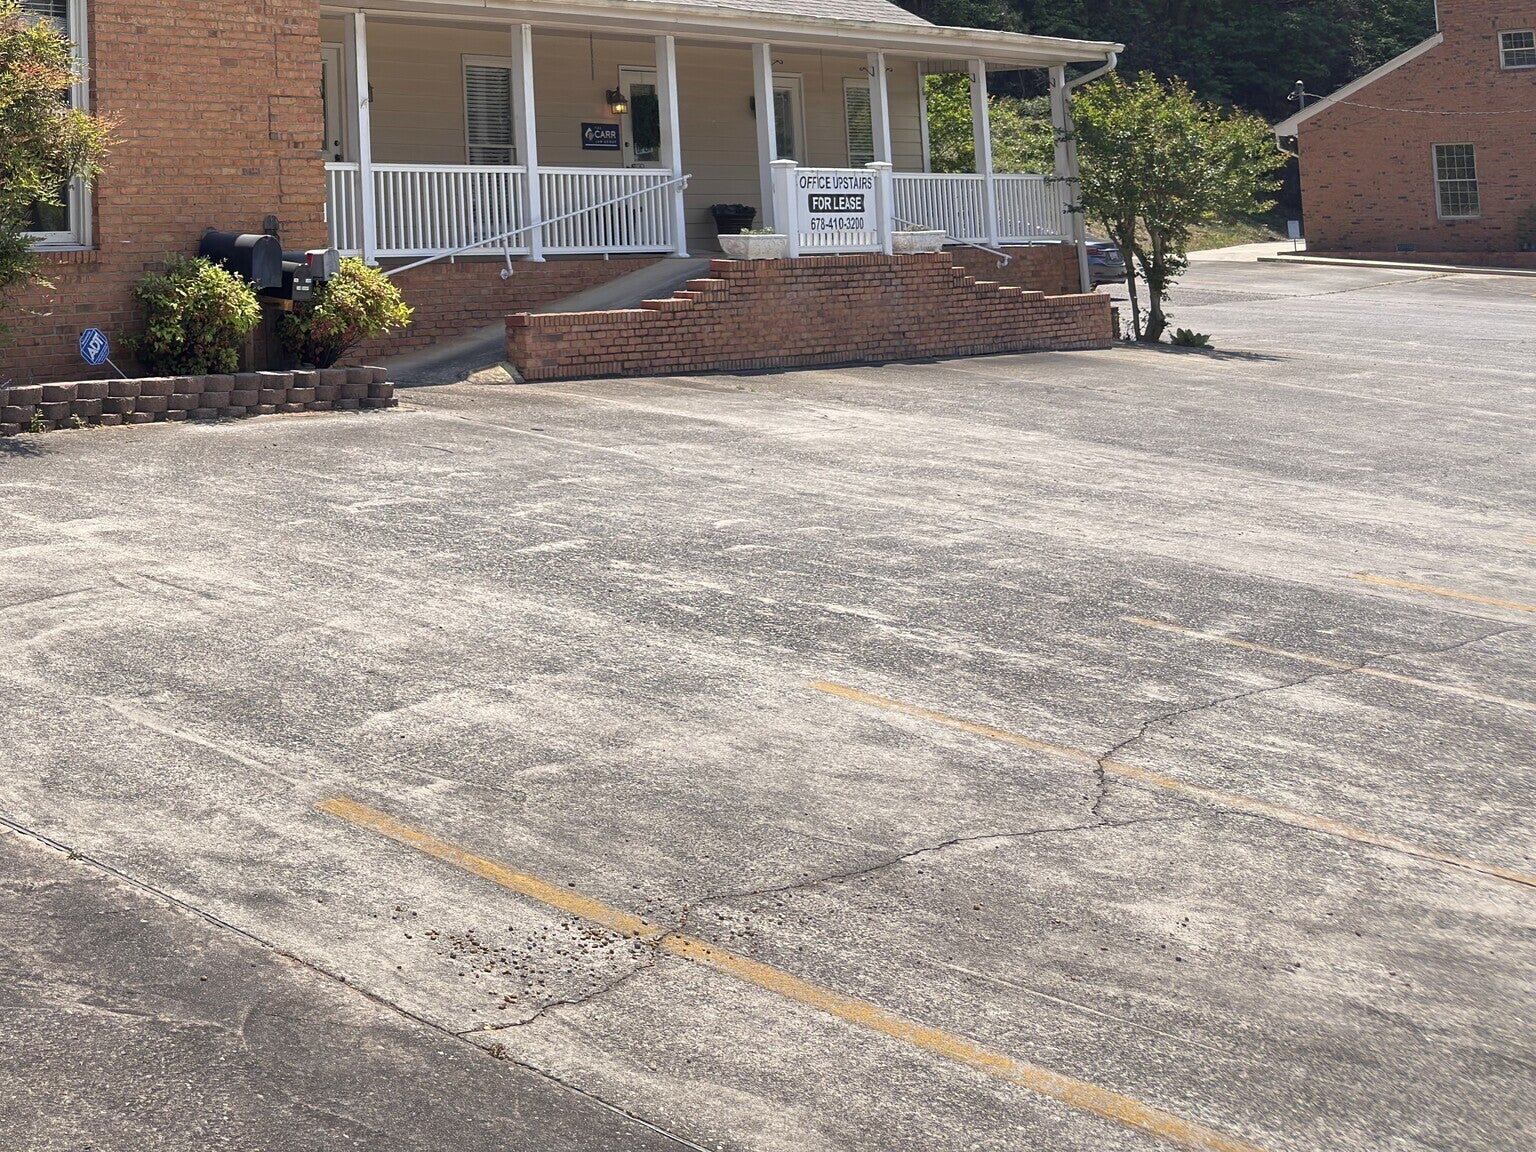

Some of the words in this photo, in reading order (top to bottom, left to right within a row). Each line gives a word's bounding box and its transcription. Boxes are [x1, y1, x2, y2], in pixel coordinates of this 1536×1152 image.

[594, 130, 616, 139] CARR
[799, 176, 831, 189] OFFICE
[833, 176, 872, 189] UPSTAIRS
[812, 196, 832, 210] FOR
[833, 196, 862, 210] LEASE
[810, 217, 864, 231] 678-410-3200
[88, 331, 104, 360] ADT
